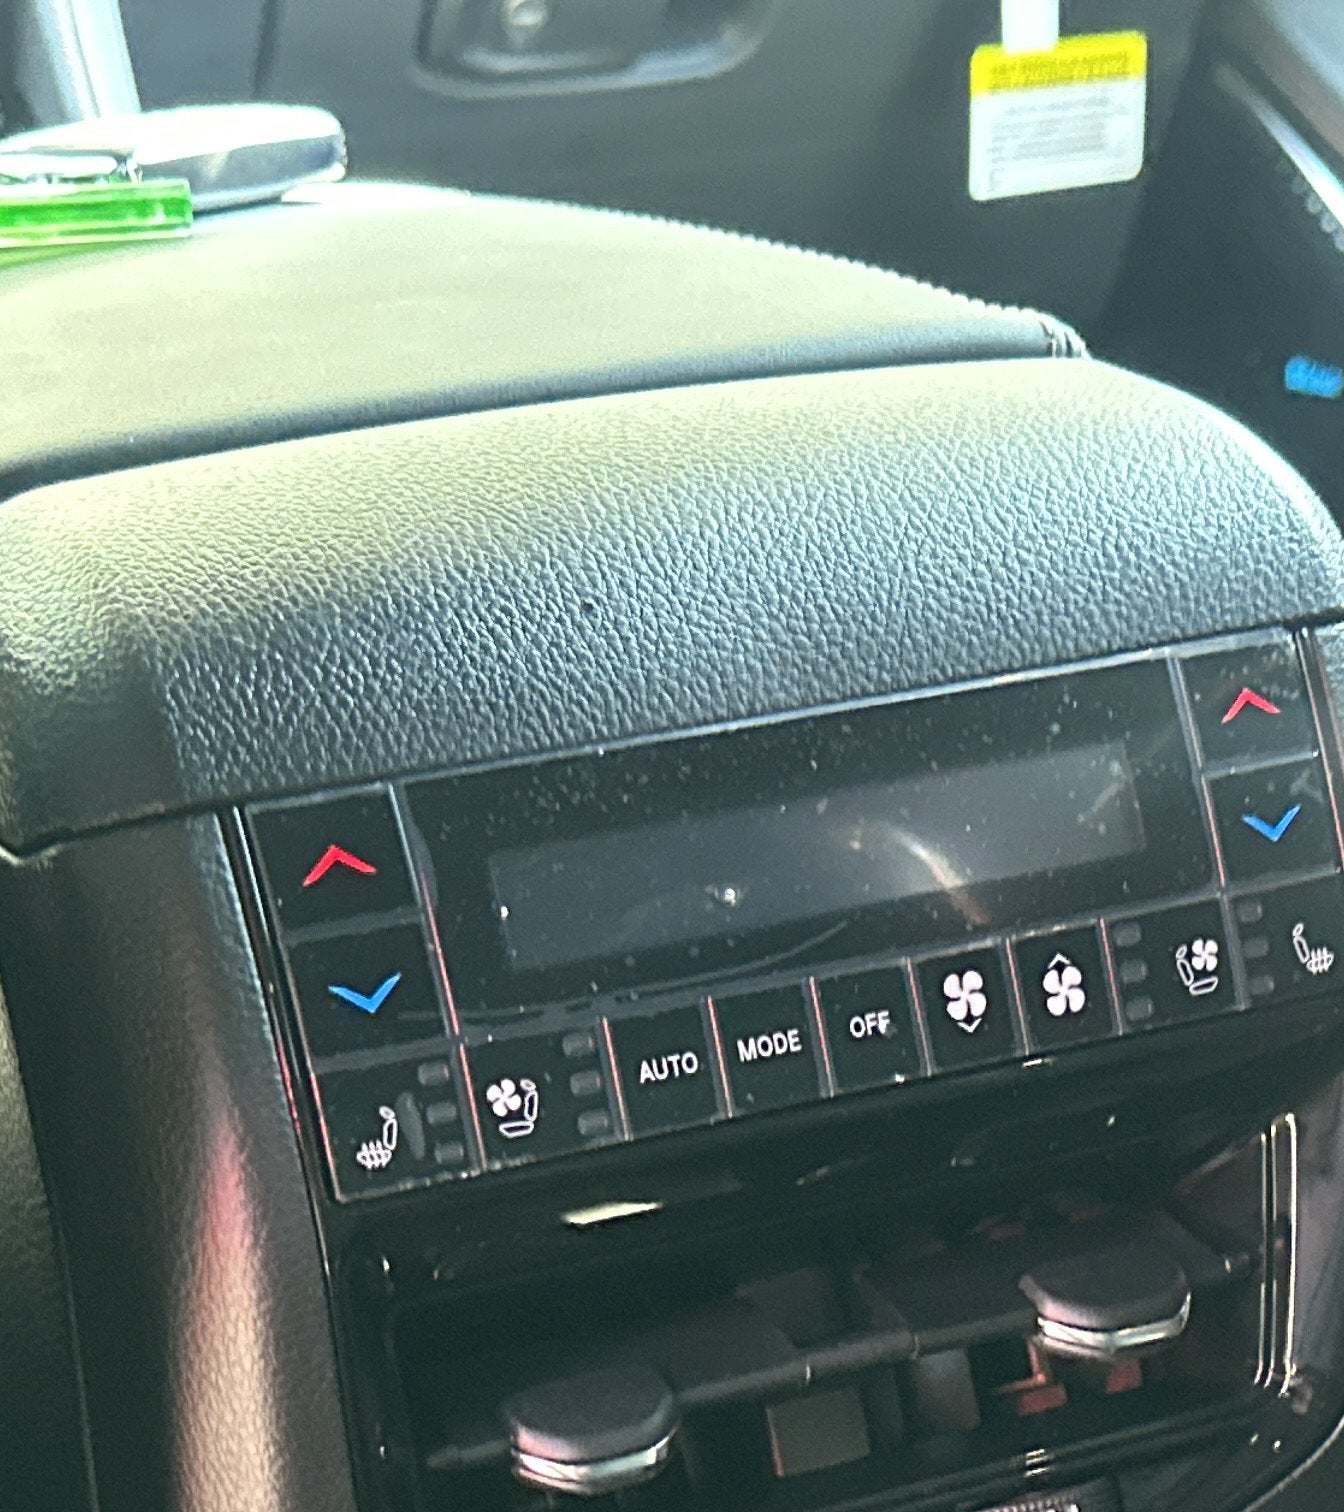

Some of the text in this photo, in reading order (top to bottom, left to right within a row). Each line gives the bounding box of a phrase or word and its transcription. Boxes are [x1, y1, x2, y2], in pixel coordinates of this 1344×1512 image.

[849, 1009, 891, 1038] OFF
[736, 1028, 803, 1062] MODE
[639, 1051, 699, 1084] AUTO
